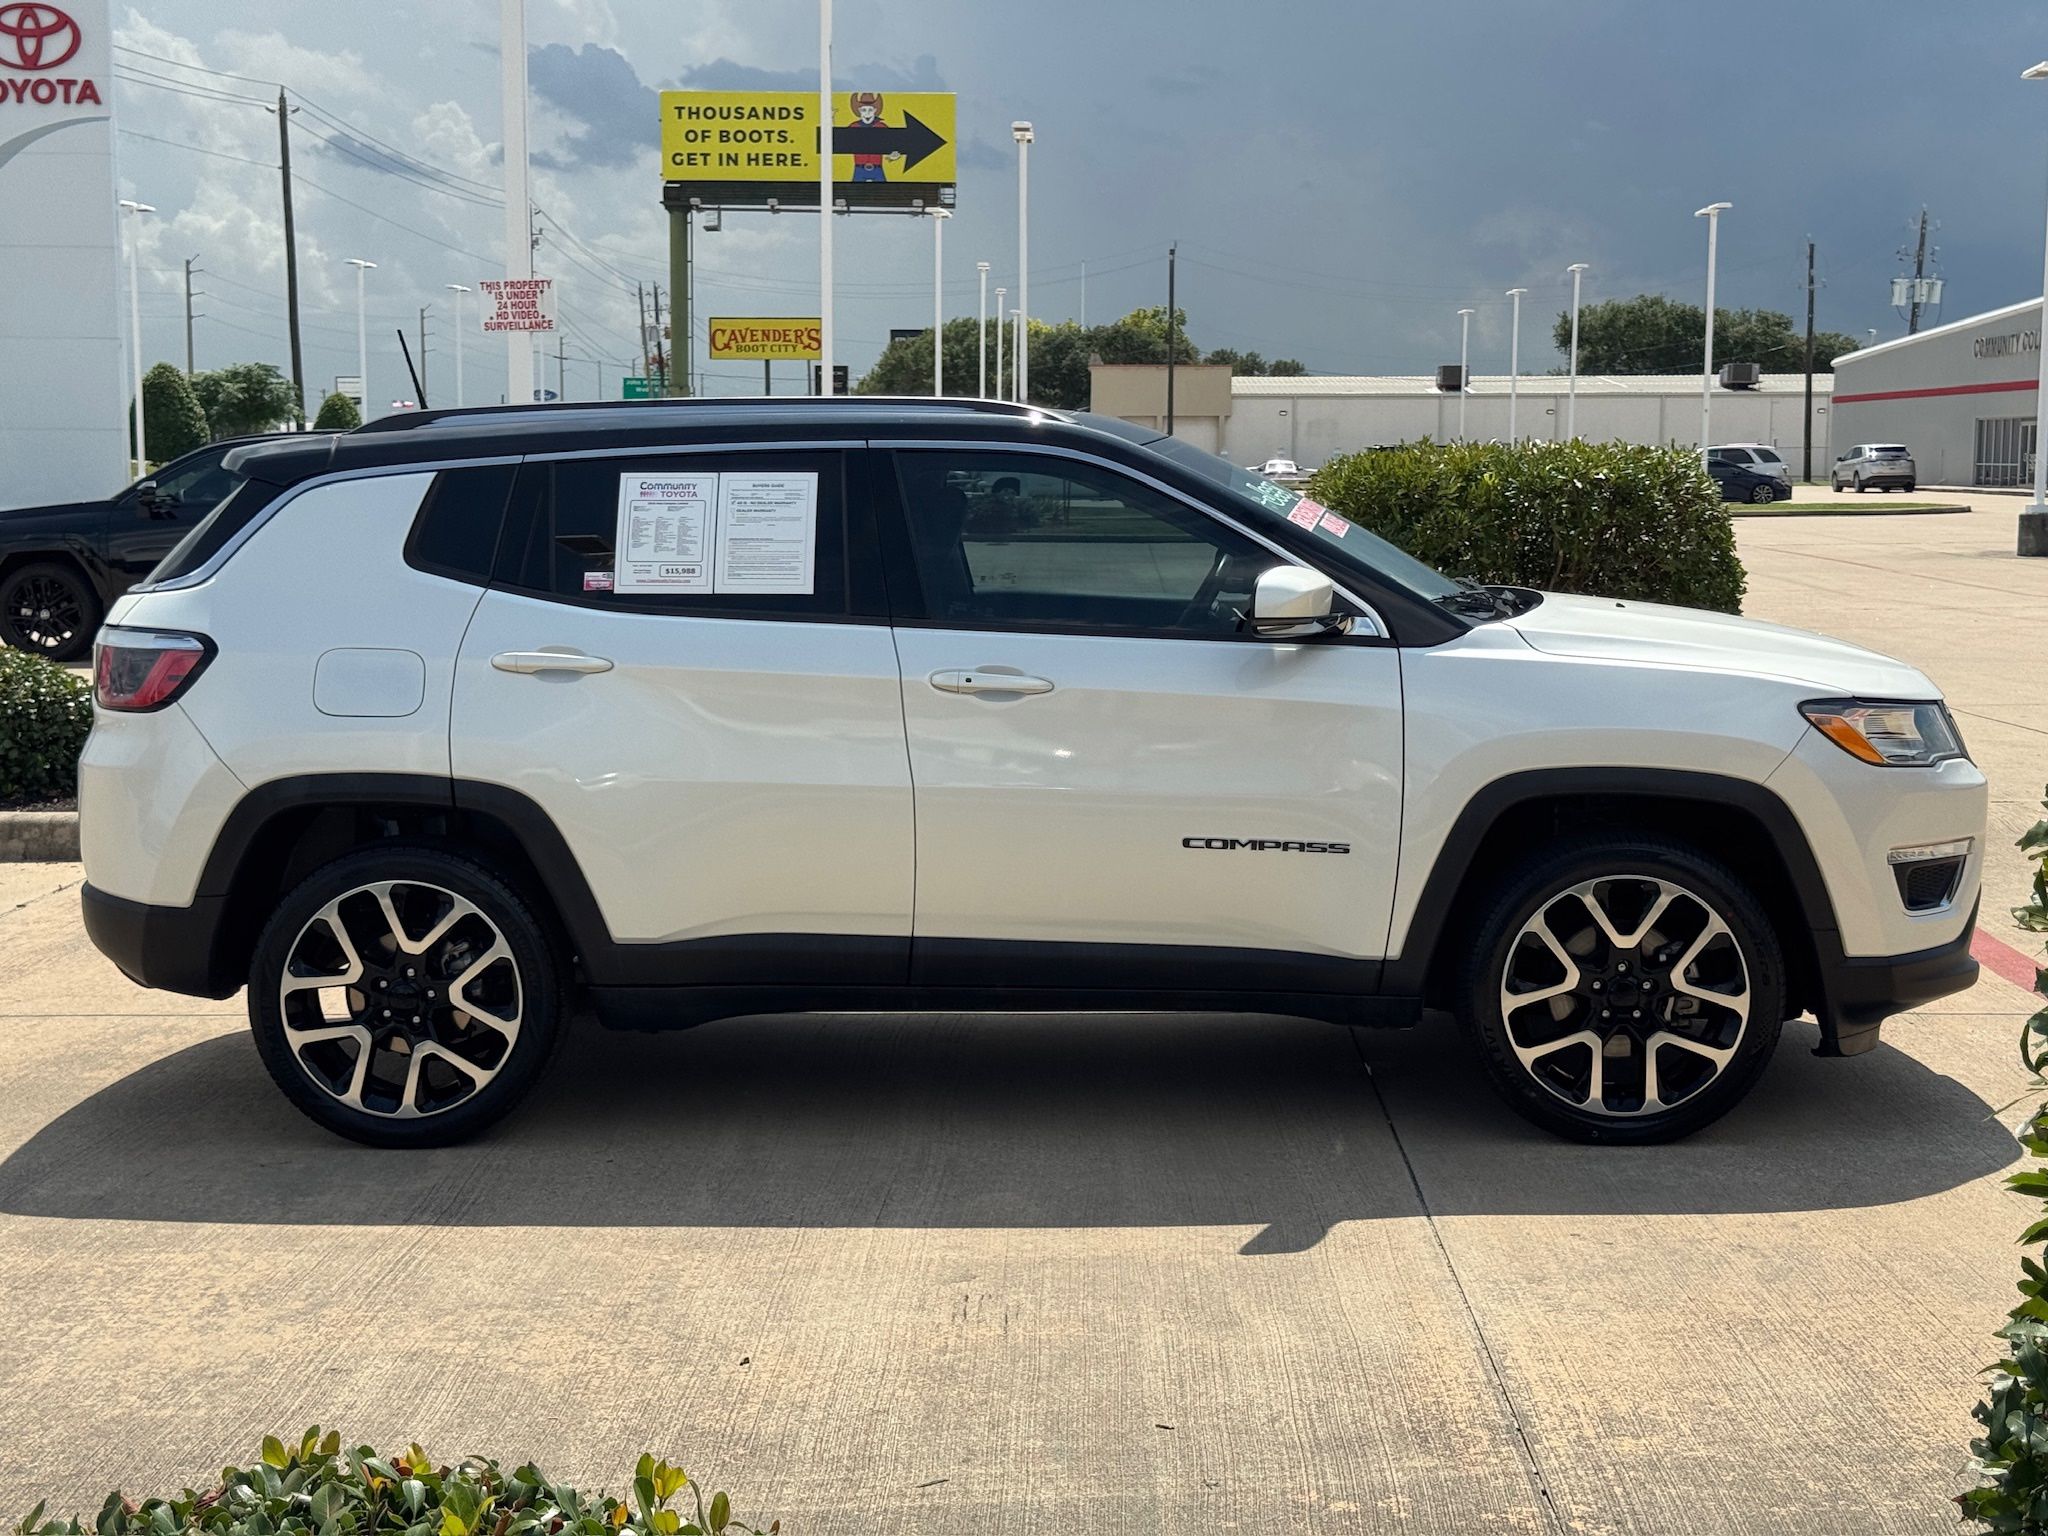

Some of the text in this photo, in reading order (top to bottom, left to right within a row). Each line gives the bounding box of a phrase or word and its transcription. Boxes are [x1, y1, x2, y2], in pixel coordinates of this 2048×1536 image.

[674, 106, 805, 120] THOUSANDS
[684, 129, 795, 143] OF BOOTS.
[671, 152, 809, 167] GET IN HERE.
[479, 279, 553, 291] THIS PROPERTY
[494, 290, 538, 300] IS UNDER
[497, 300, 537, 310] 24 HOUR
[495, 310, 540, 321] HD VIDEO
[484, 320, 554, 332] SURVEILLANCE
[711, 327, 821, 352] CAVENDER'S
[735, 343, 799, 353] BOOT CITY
[660, 490, 698, 498] TOYOTA
[1182, 837, 1351, 854] COMPASS
